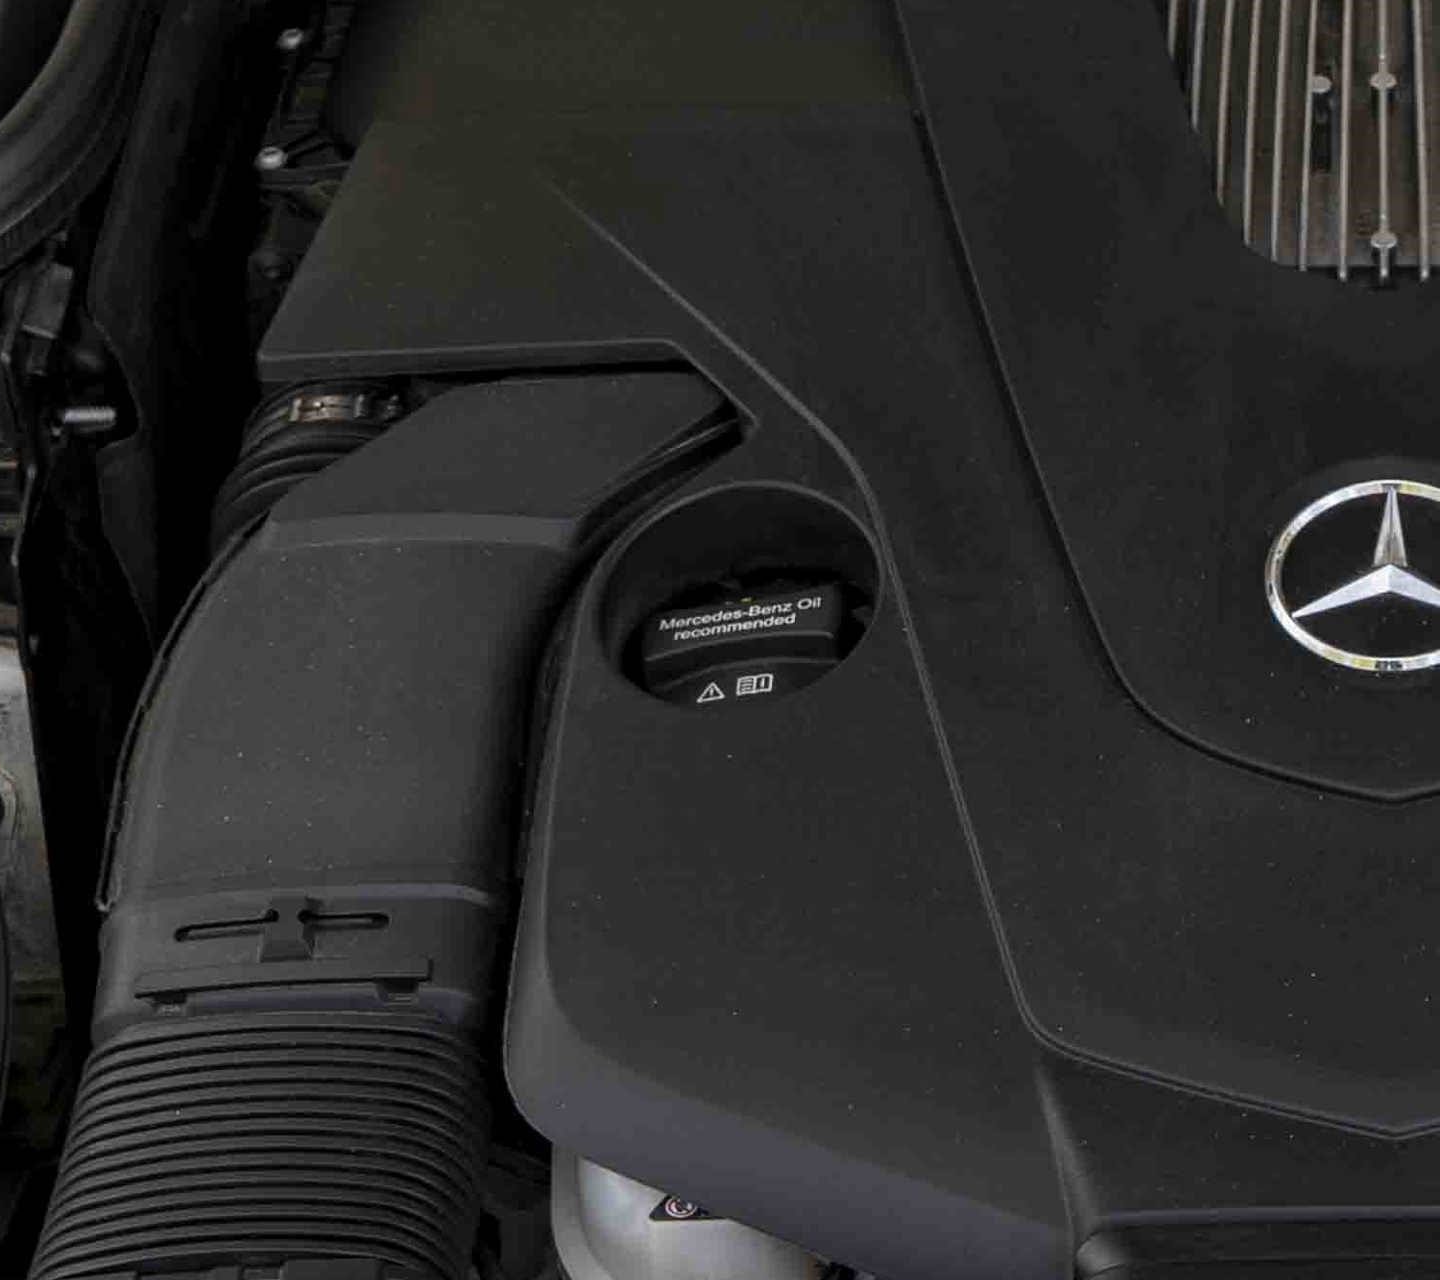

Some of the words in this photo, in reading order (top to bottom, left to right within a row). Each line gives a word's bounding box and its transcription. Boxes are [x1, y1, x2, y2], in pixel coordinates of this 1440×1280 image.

[659, 602, 793, 631] Mercedes-Benz
[796, 596, 823, 611] Oil
[673, 612, 797, 641] recommended
